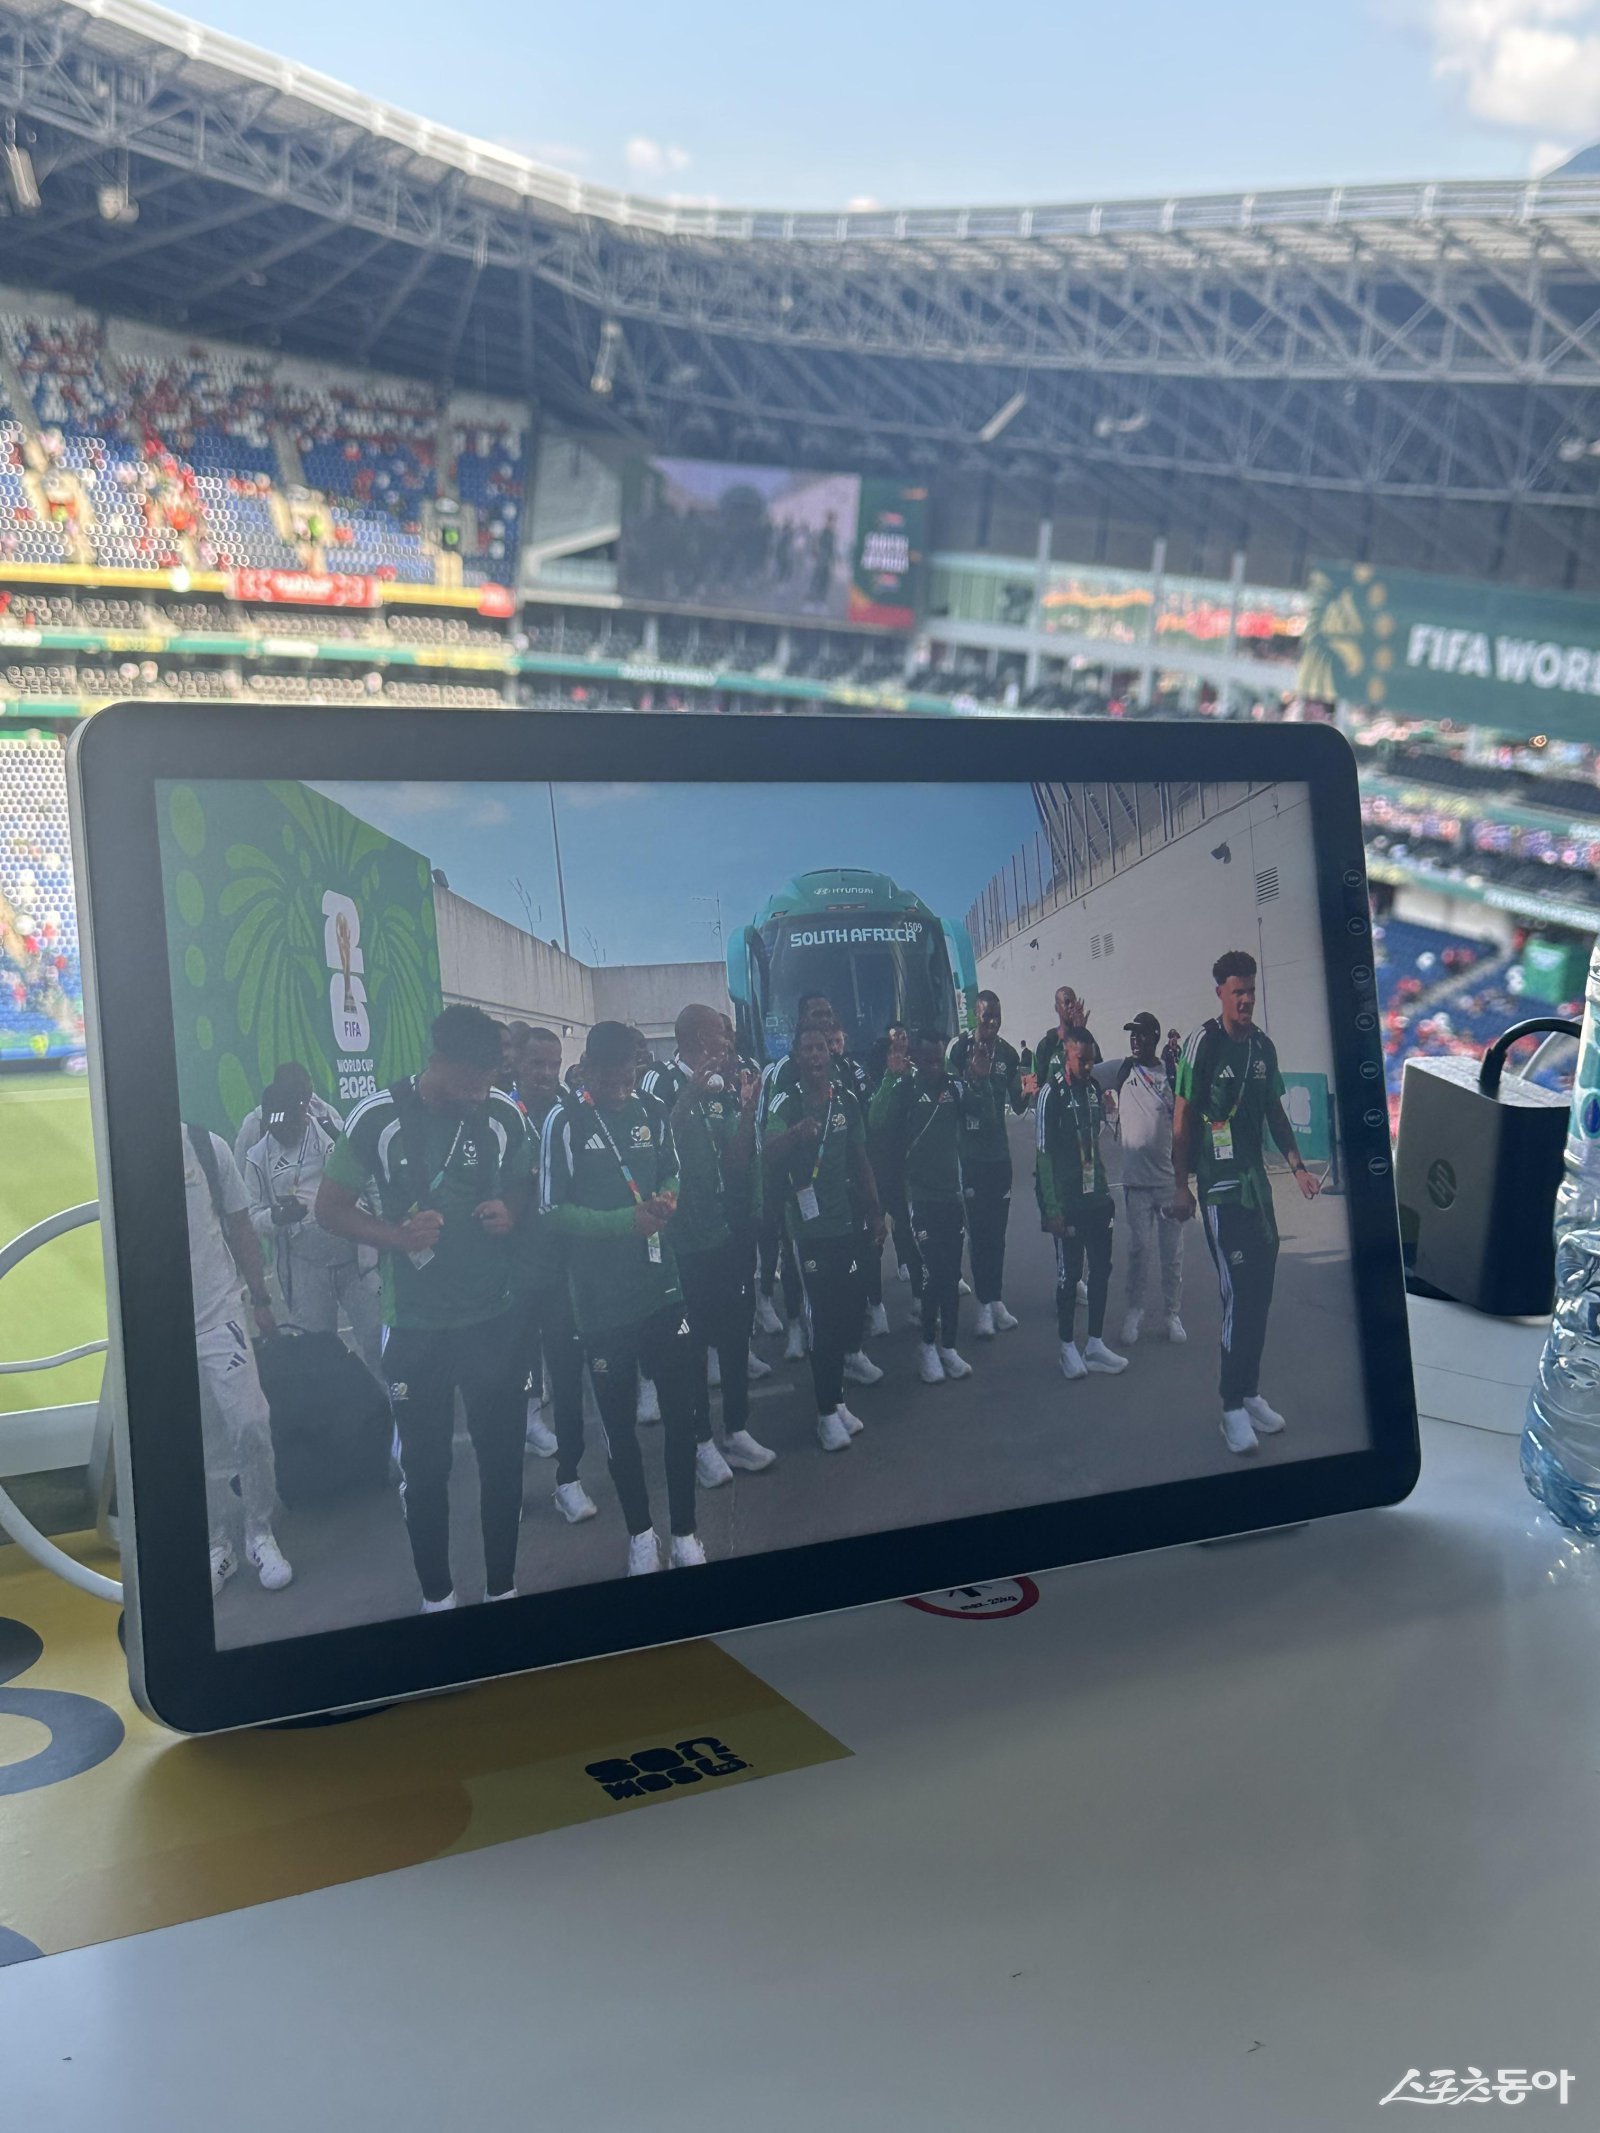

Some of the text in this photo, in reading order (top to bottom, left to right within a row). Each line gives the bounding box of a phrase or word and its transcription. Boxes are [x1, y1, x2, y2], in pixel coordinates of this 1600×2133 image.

[1406, 623, 1492, 678] FIFA
[832, 887, 874, 895] HYUNDAI
[903, 922, 922, 933] 1509
[791, 928, 917, 947] SOUTH AFRICA
[344, 1021, 361, 1038] FIFA
[336, 1058, 361, 1073] WORLD
[339, 1075, 376, 1099] 2026
